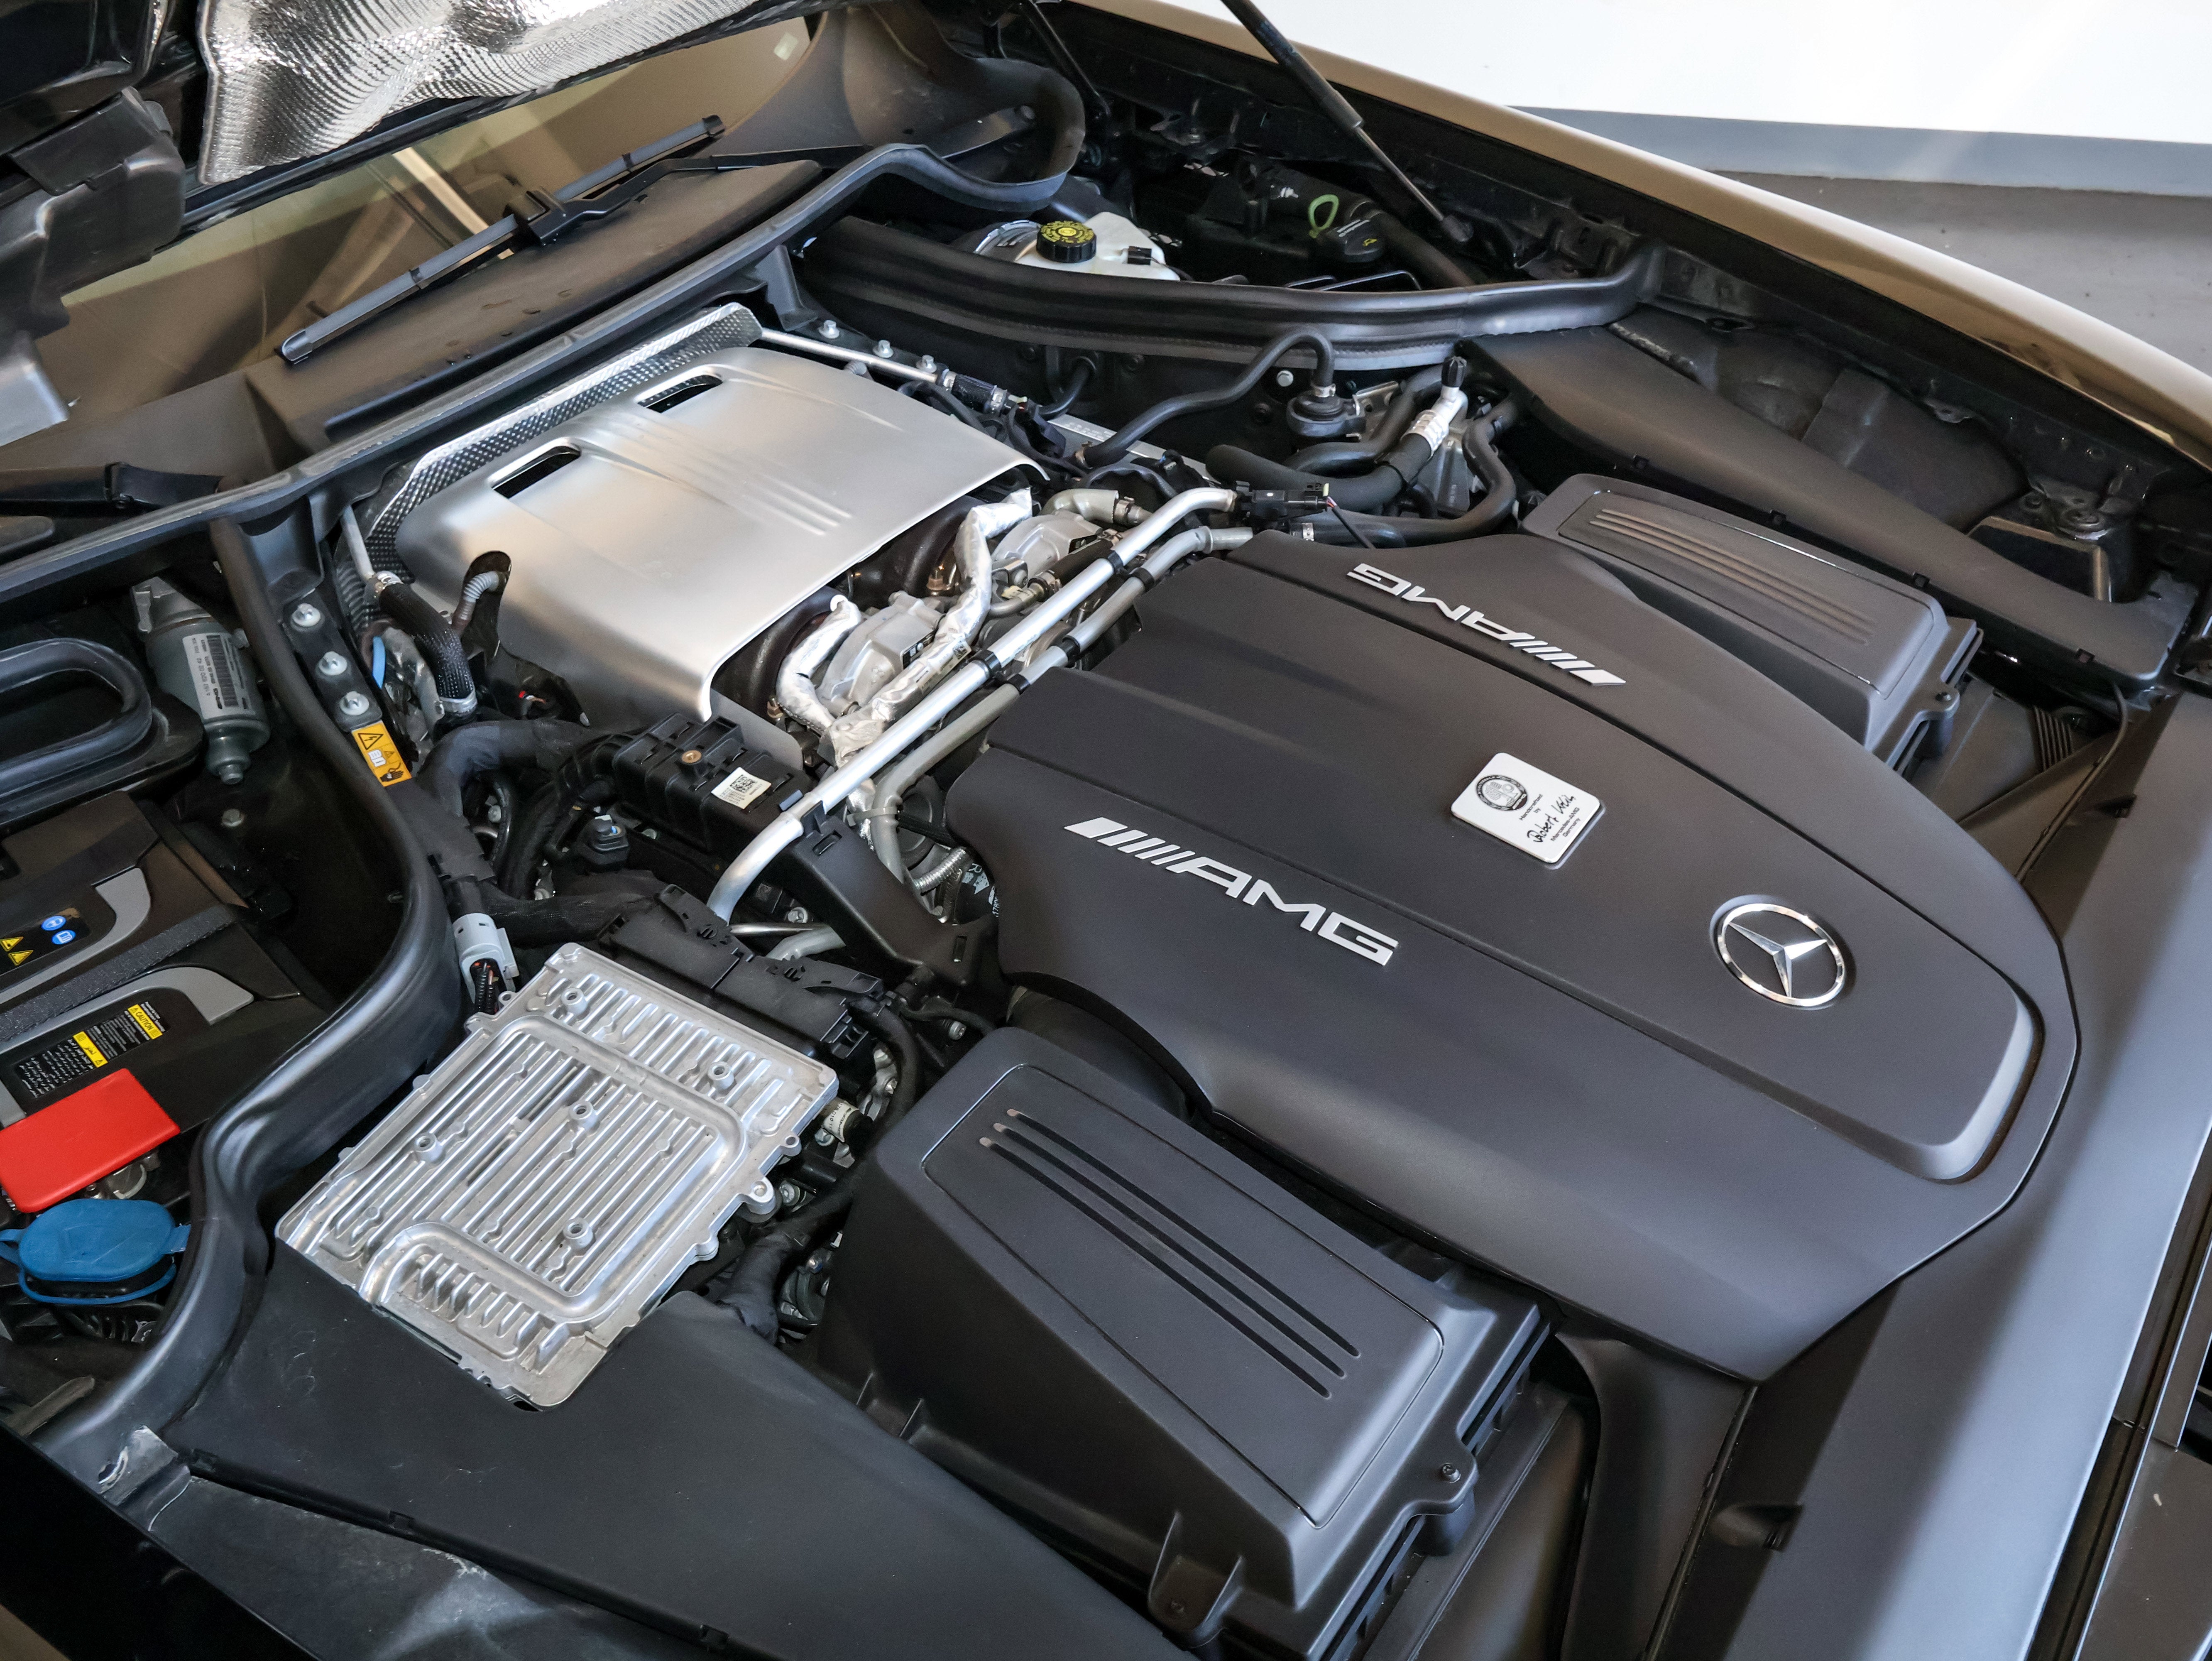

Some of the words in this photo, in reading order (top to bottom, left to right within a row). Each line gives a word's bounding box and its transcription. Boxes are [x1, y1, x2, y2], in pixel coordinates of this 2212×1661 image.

[1346, 563, 1536, 641] AMG
[1519, 794, 1543, 821] Handcrafted
[1550, 807, 1580, 841] Mercedes-AMG
[1562, 818, 1581, 837] Germany
[1165, 856, 1399, 966] AMG
[135, 1012, 154, 1030] CAUTION
